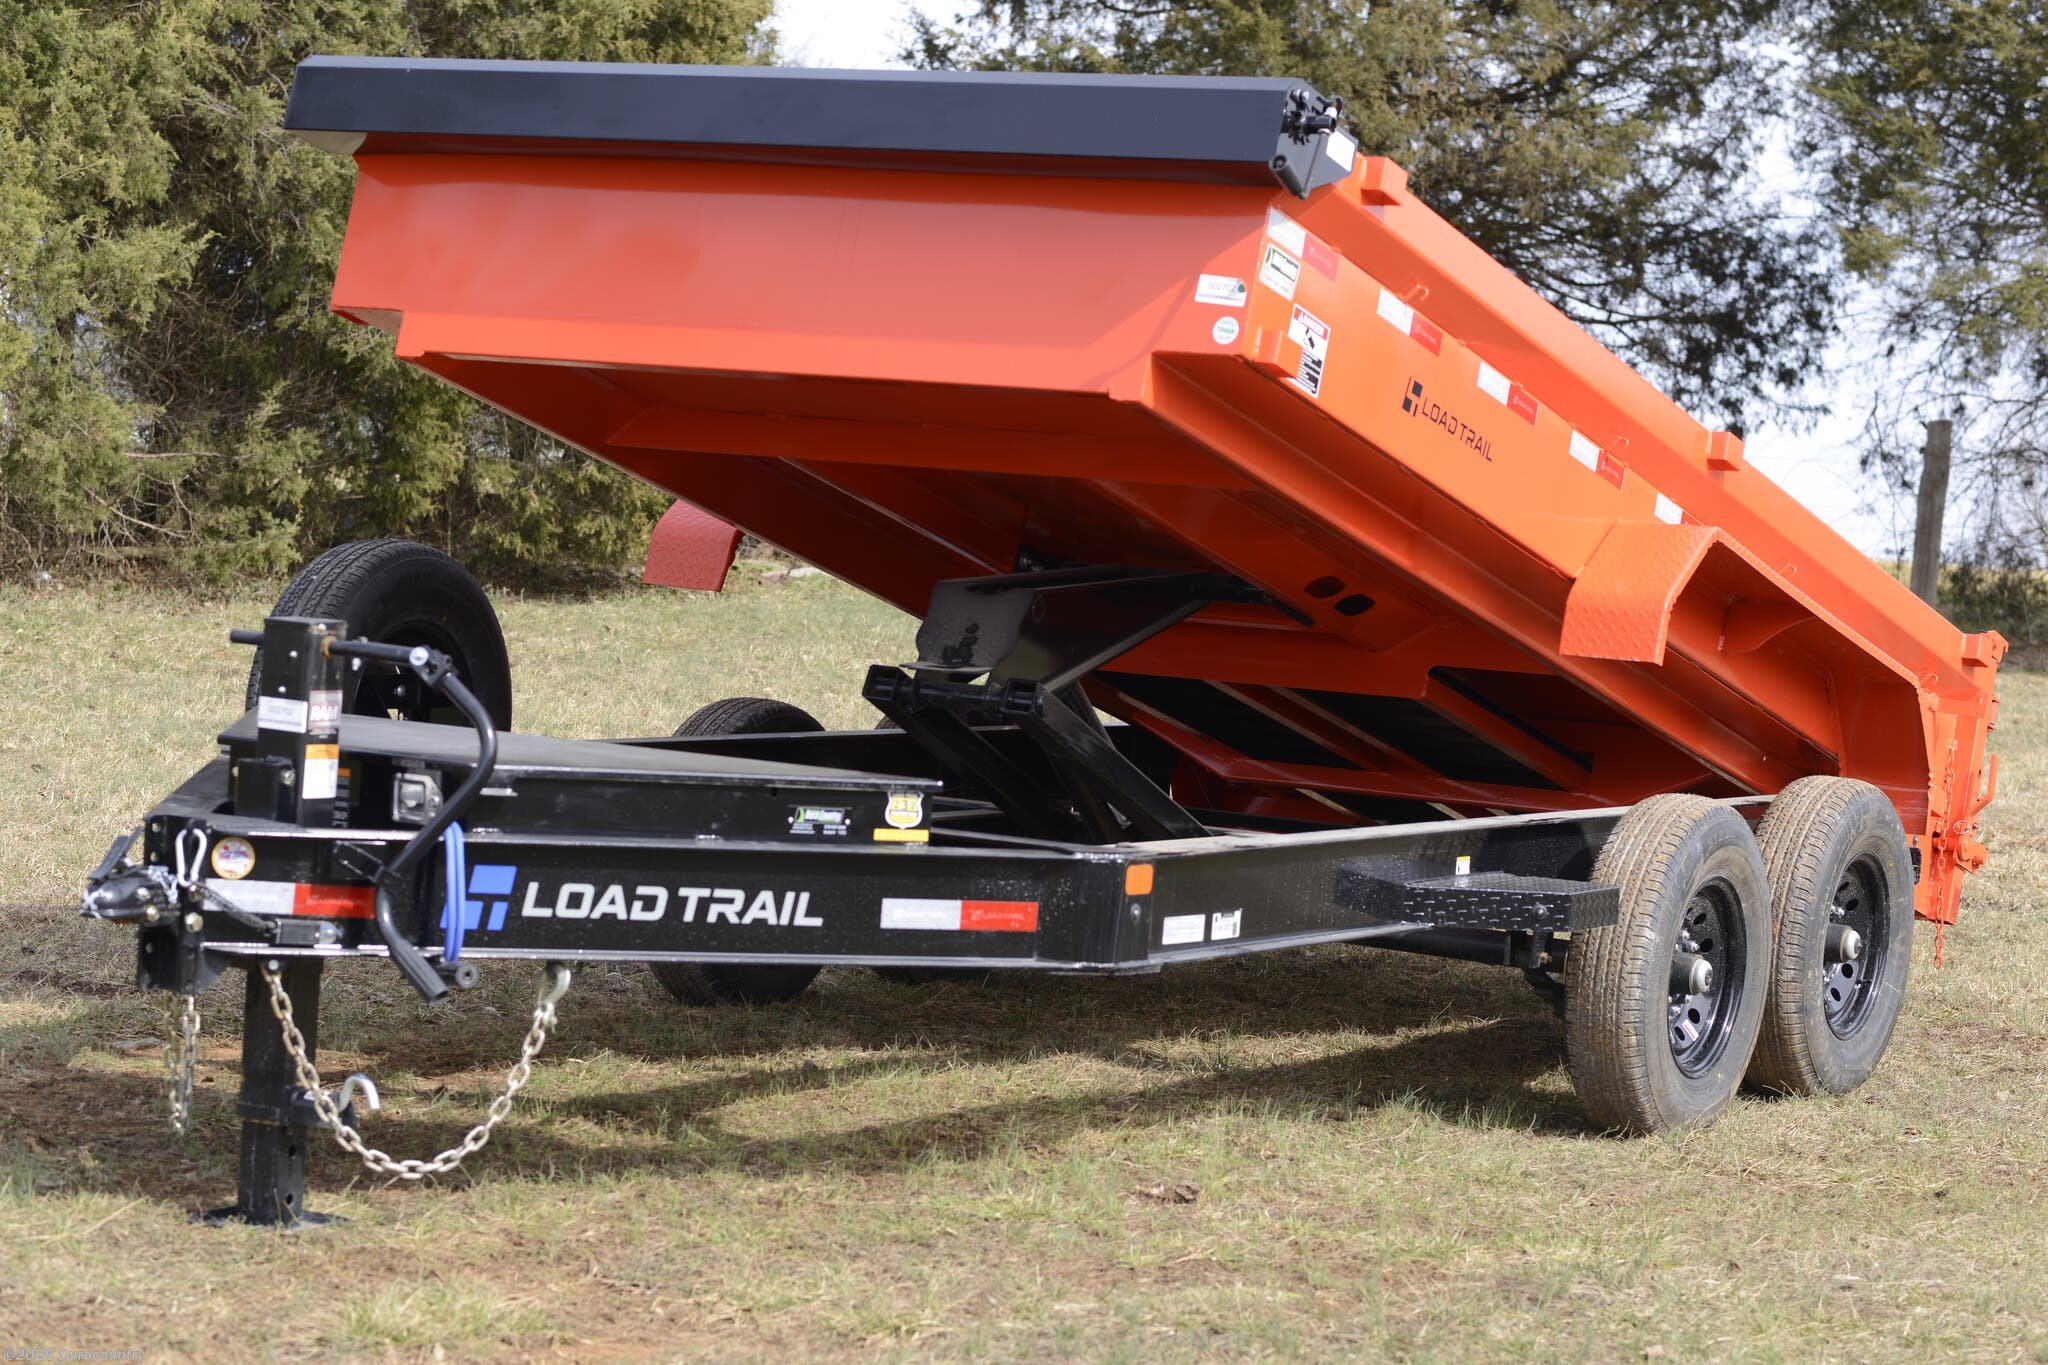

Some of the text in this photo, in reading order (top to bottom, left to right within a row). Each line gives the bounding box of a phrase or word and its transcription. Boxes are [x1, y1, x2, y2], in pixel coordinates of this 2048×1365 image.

[1421, 397, 1493, 462] LOAD TRAIL
[521, 881, 825, 928] LOAD TRAIL
